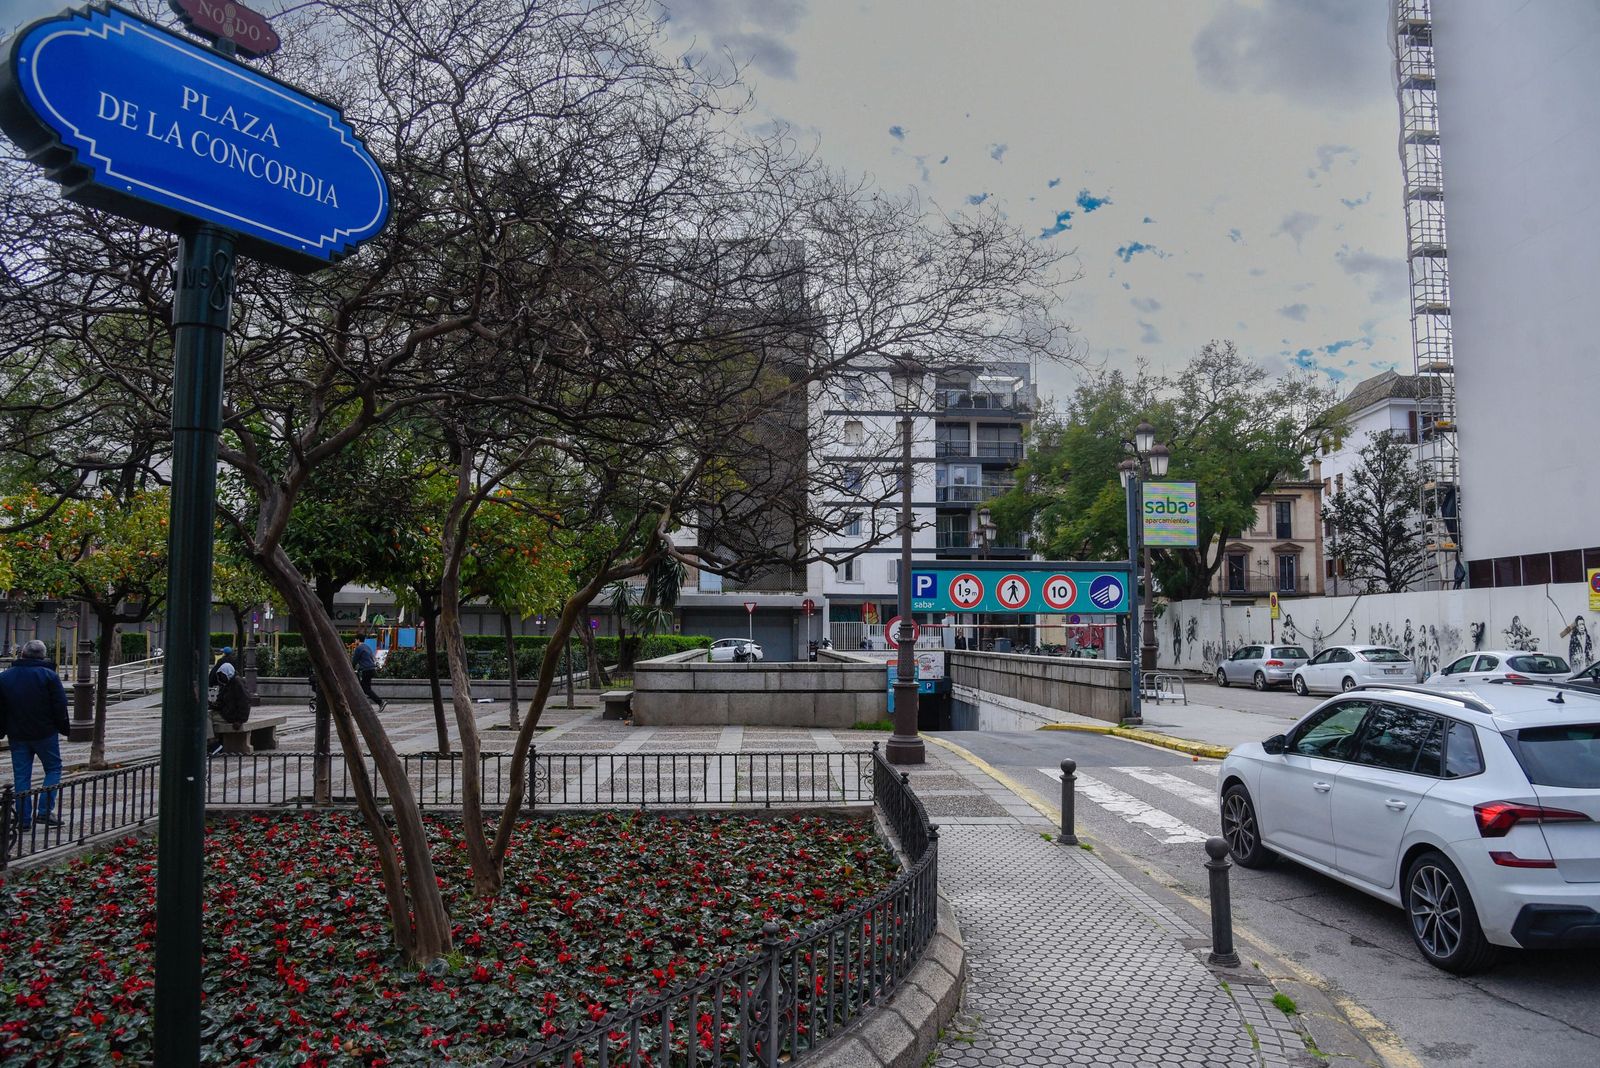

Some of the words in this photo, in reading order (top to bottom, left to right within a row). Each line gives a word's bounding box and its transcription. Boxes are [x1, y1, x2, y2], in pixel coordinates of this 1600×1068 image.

[181, 85, 281, 148] PLAZA
[97, 90, 140, 131] DE
[146, 111, 185, 150] LA
[191, 130, 339, 209] CONCORDIA
[1145, 496, 1188, 514] saba
[1145, 517, 1190, 525] aparcamientos
[917, 575, 932, 596] P
[1052, 586, 1067, 598] 10
[914, 600, 932, 609] saba
